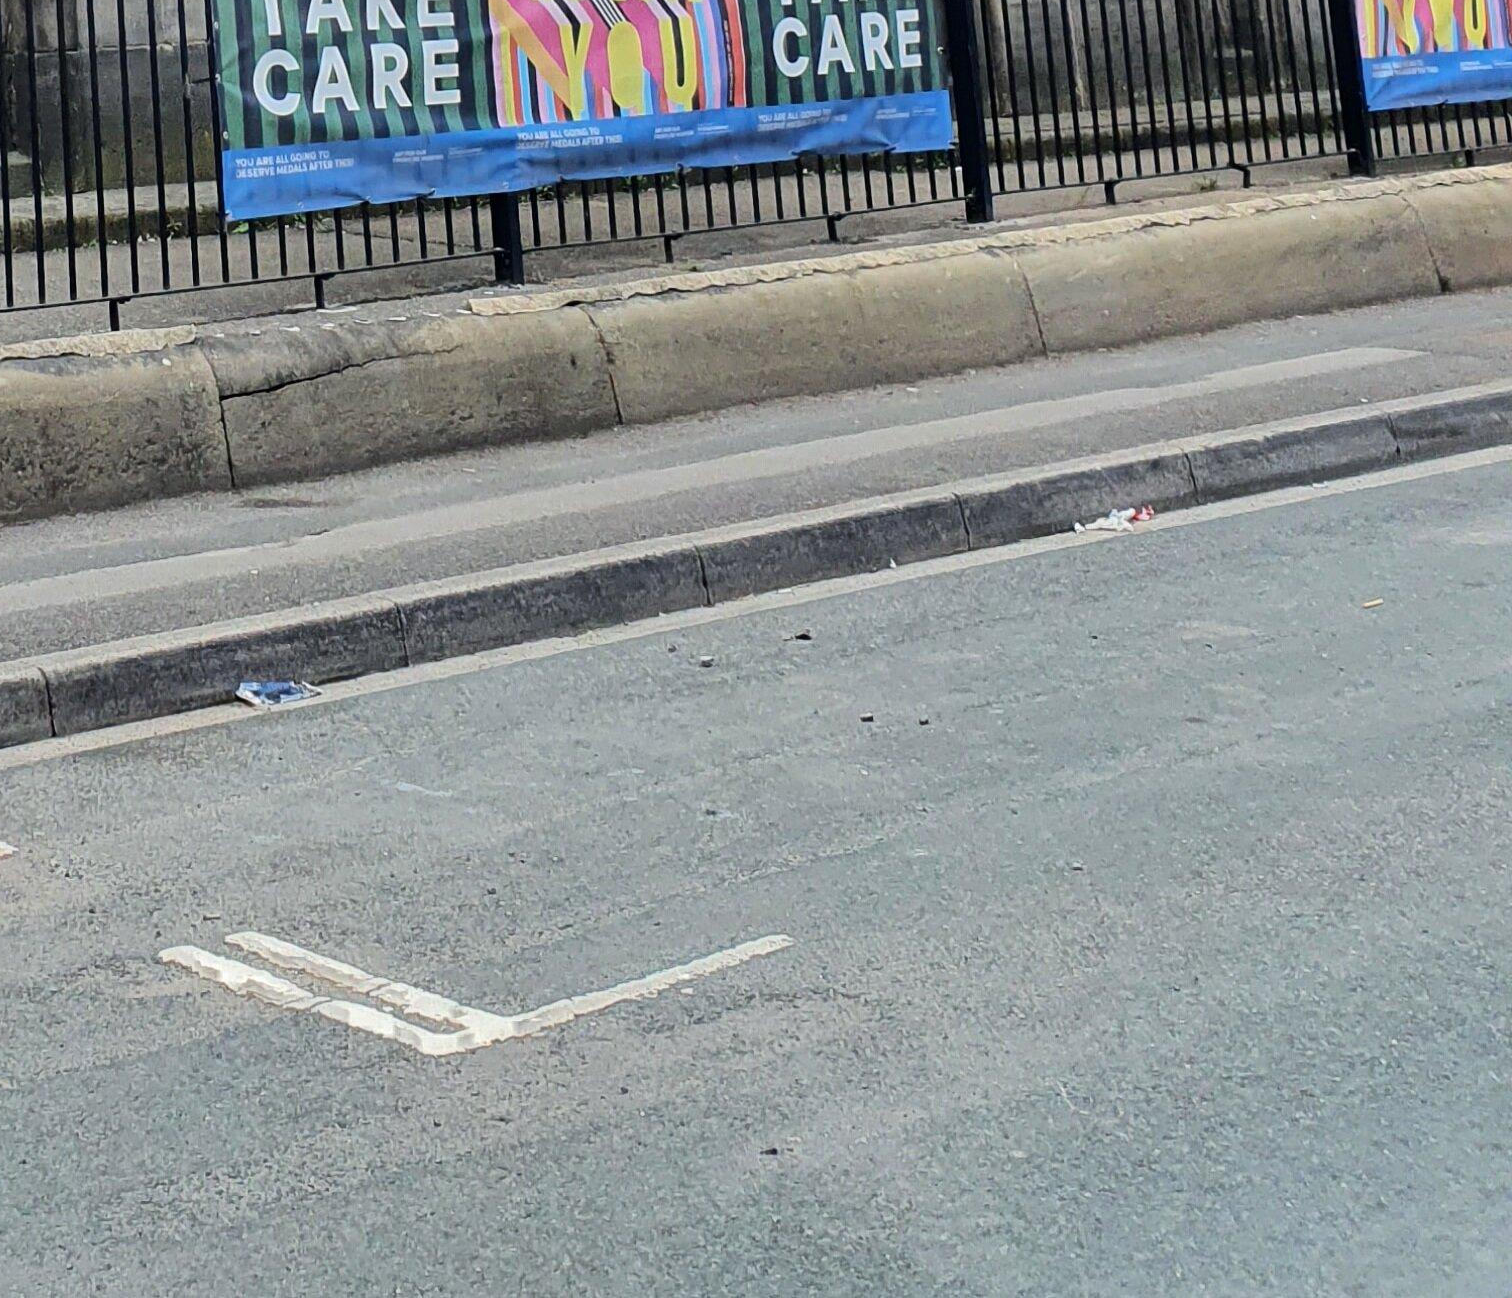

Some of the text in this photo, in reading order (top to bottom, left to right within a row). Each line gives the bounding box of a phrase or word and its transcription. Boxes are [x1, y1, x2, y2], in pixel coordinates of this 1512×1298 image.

[772, 9, 923, 78] CARE
[252, 39, 461, 116] CARE
[559, 20, 697, 121] YOU
[517, 131, 534, 141] YOU
[550, 130, 563, 138] ALL
[235, 149, 330, 167] YOU ARE ALL GOING TO
[235, 166, 275, 179] DESERVE
[276, 162, 308, 175] MEDALS
[308, 159, 334, 171] AFTER
